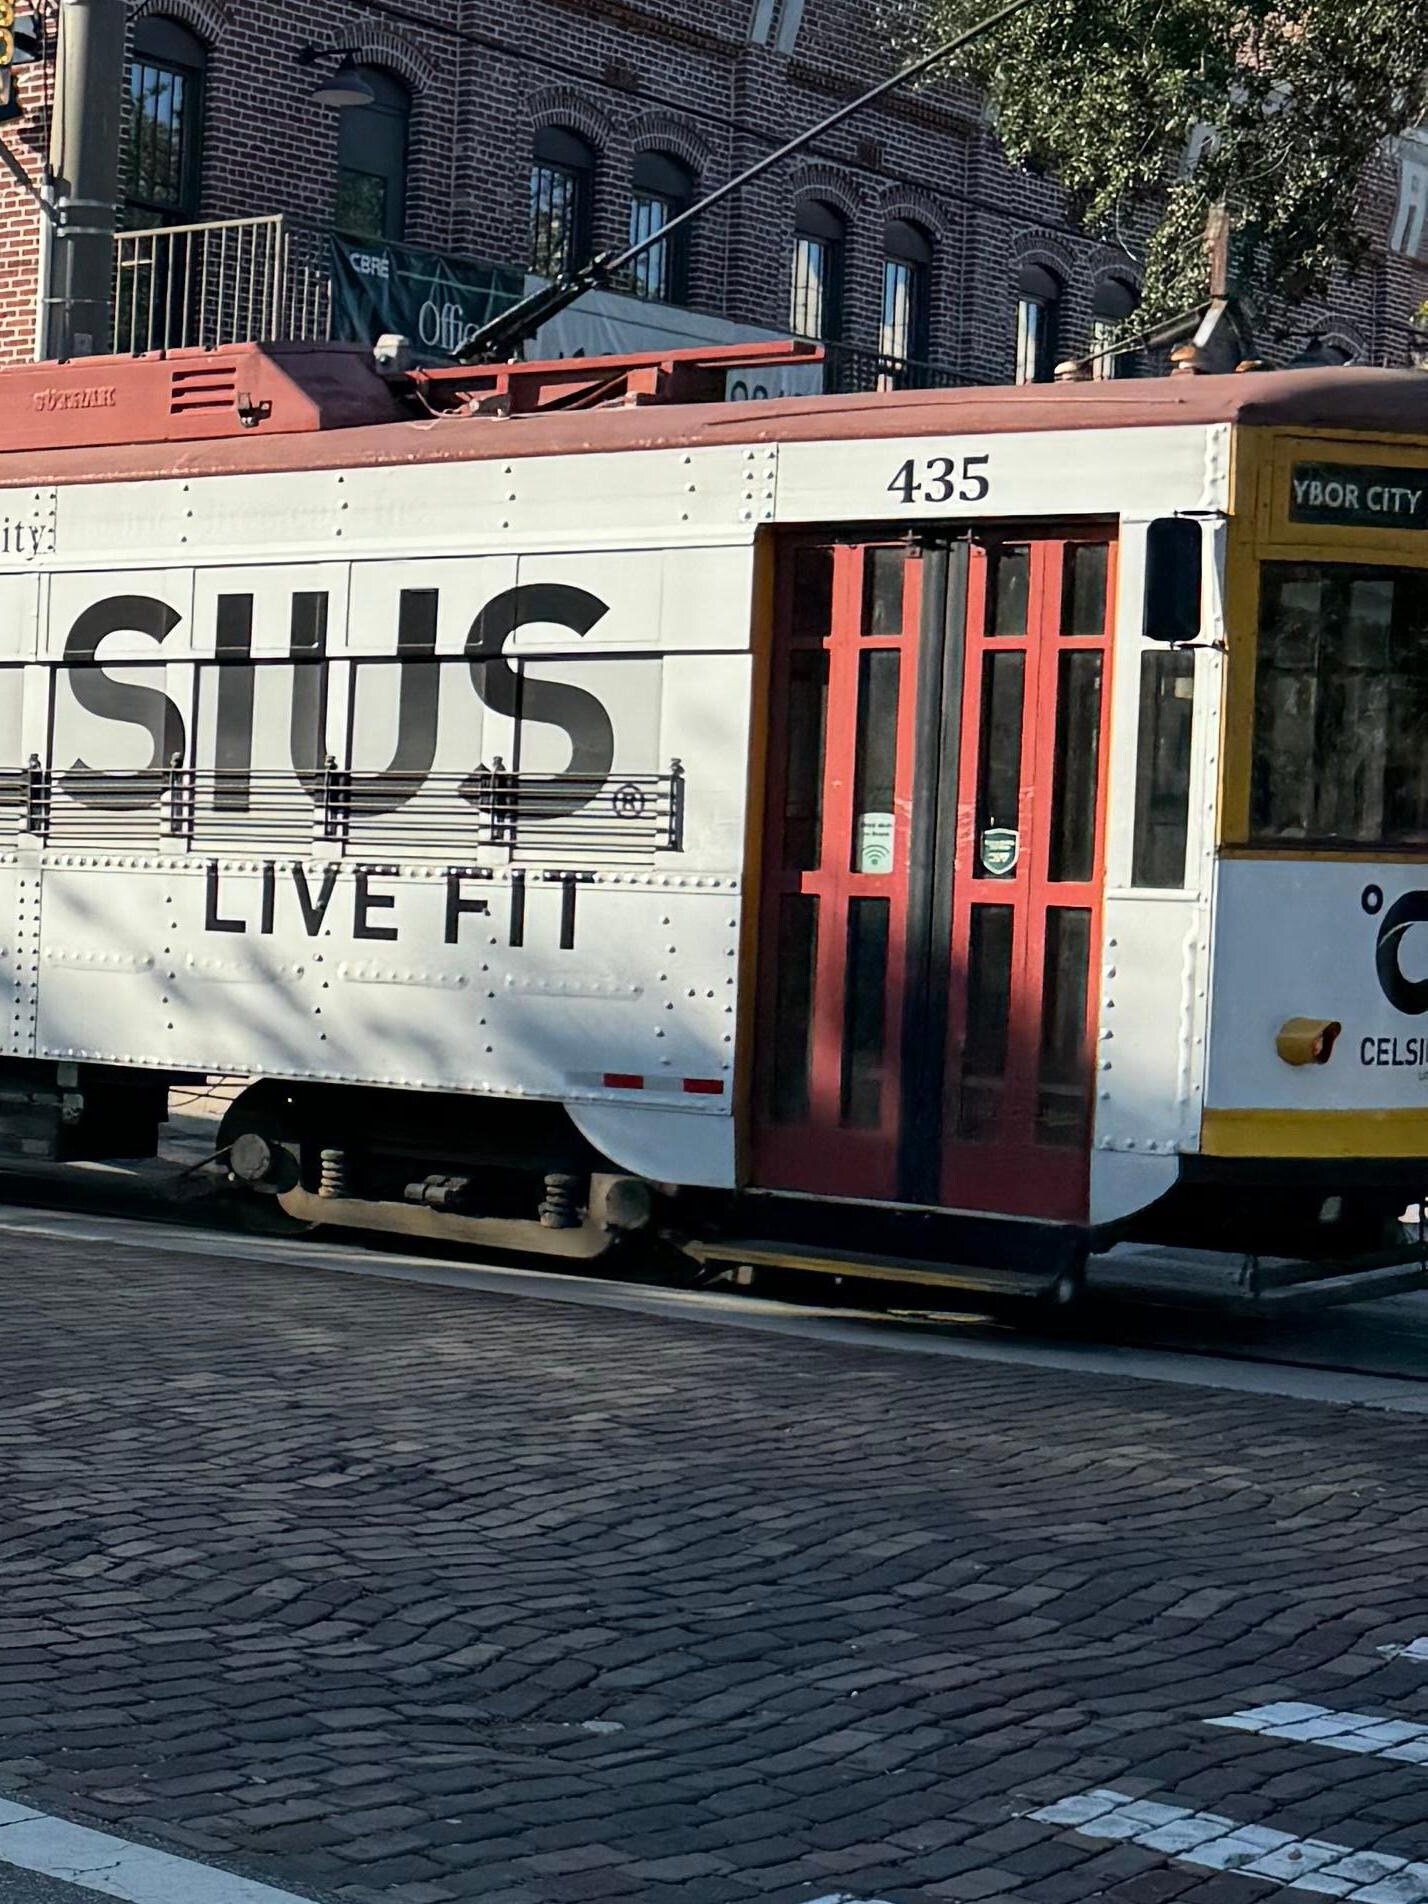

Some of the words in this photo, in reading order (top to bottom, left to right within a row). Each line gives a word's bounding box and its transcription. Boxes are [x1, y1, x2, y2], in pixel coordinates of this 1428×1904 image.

[349, 252, 390, 279] CBRE
[418, 300, 481, 350] Offic
[885, 453, 991, 504] 435
[1293, 480, 1360, 509] YBOR
[1366, 486, 1423, 514] CITY
[204, 860, 398, 941] LIVE
[444, 866, 598, 951] FIT
[1360, 1036, 1428, 1066] CELSI
